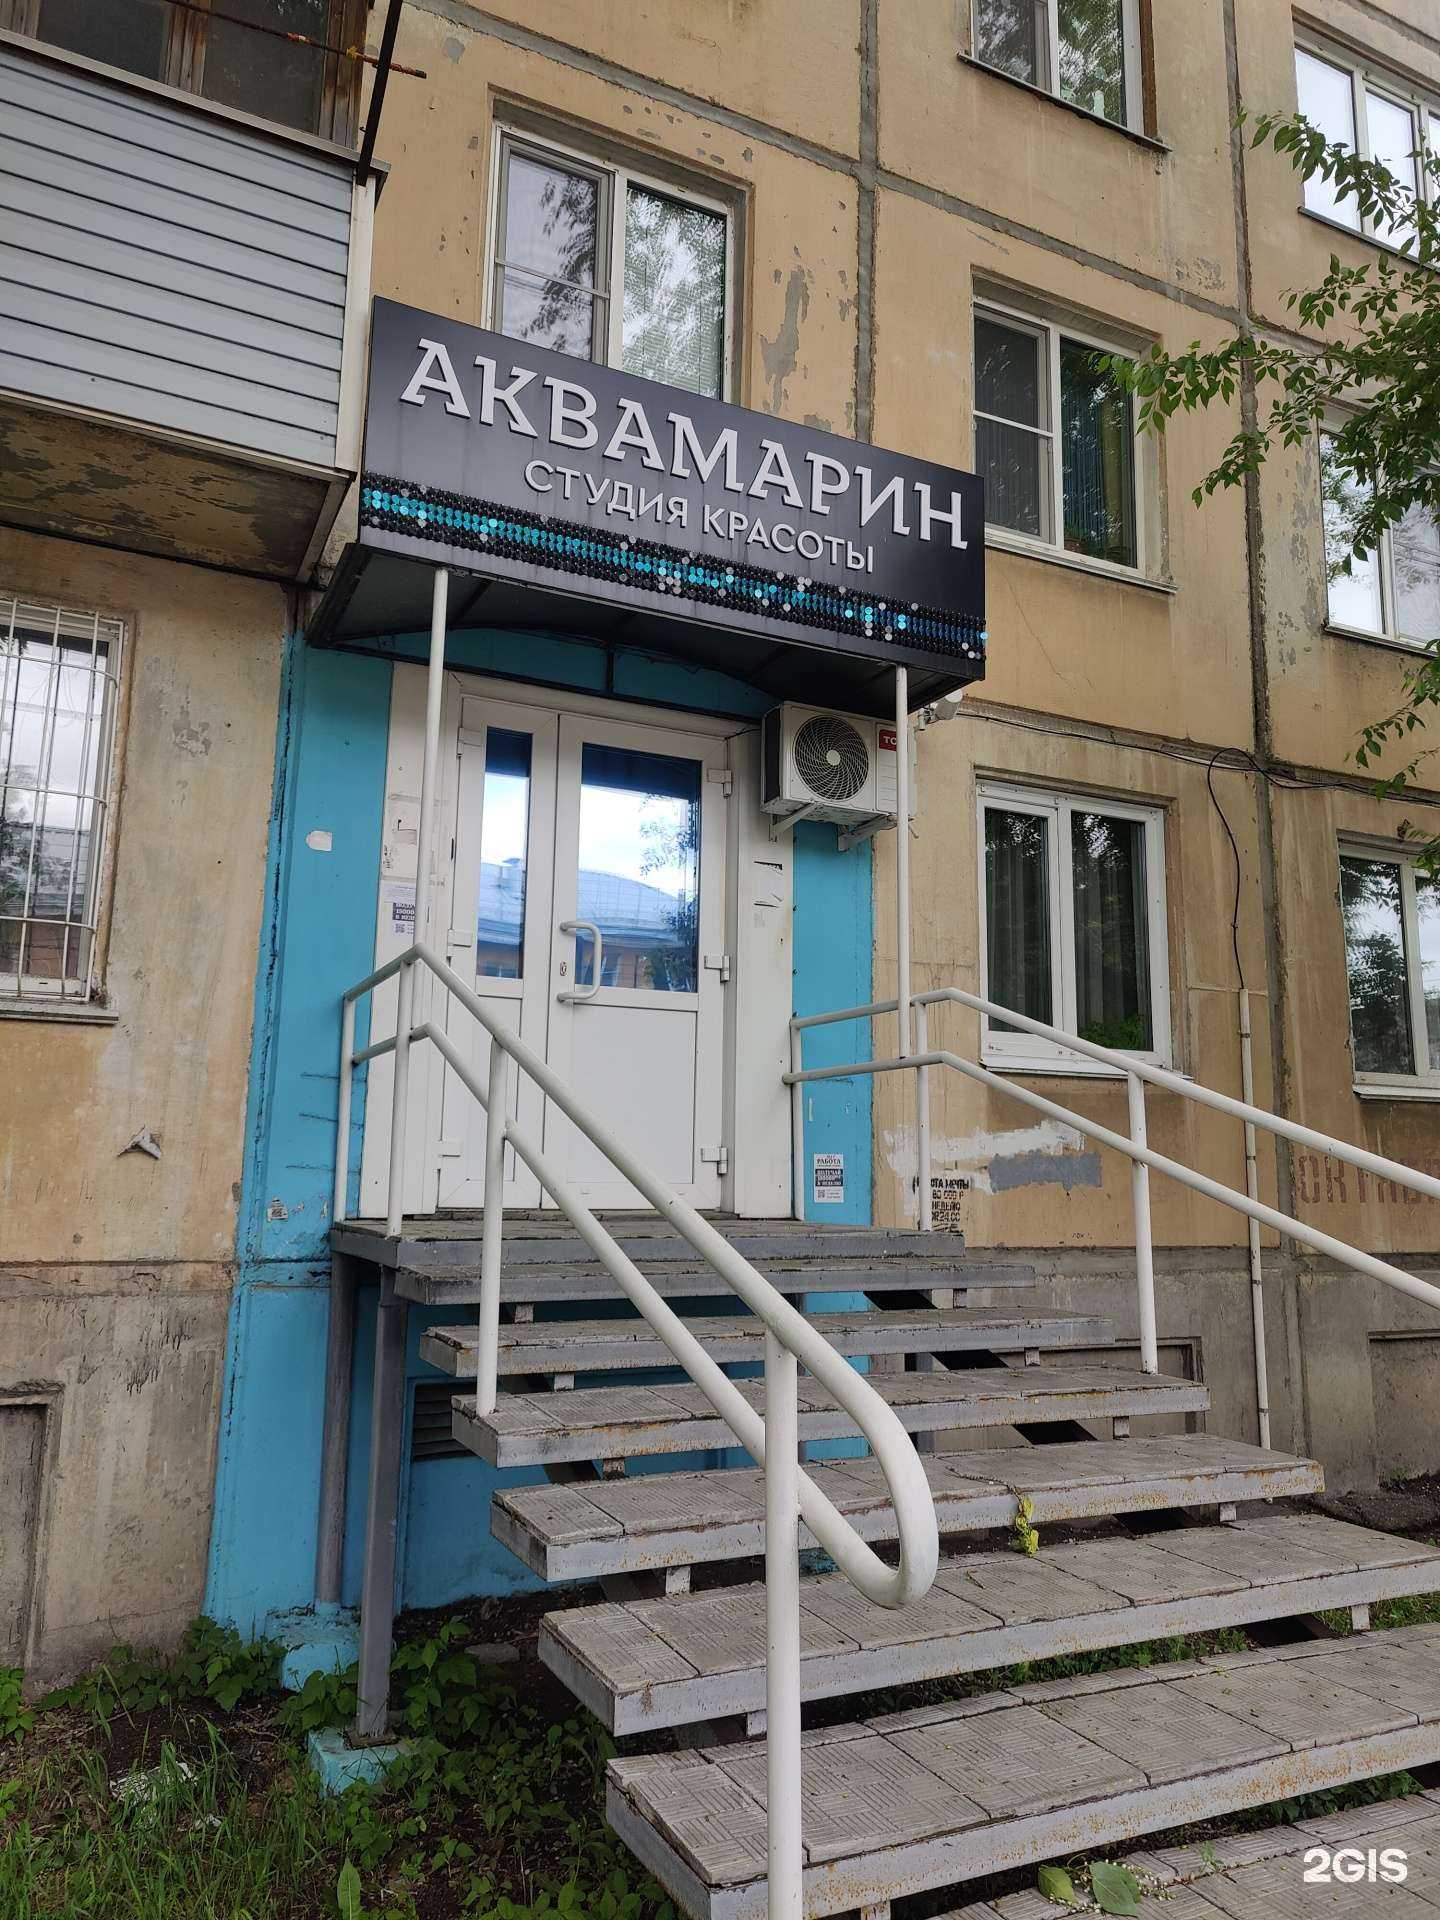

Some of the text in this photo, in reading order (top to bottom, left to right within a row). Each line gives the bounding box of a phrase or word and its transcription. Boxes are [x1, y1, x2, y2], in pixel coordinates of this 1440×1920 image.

[400, 337, 969, 551] АКВАМАРИН
[524, 459, 875, 574] СТУДИЯ КРАСОТЫ
